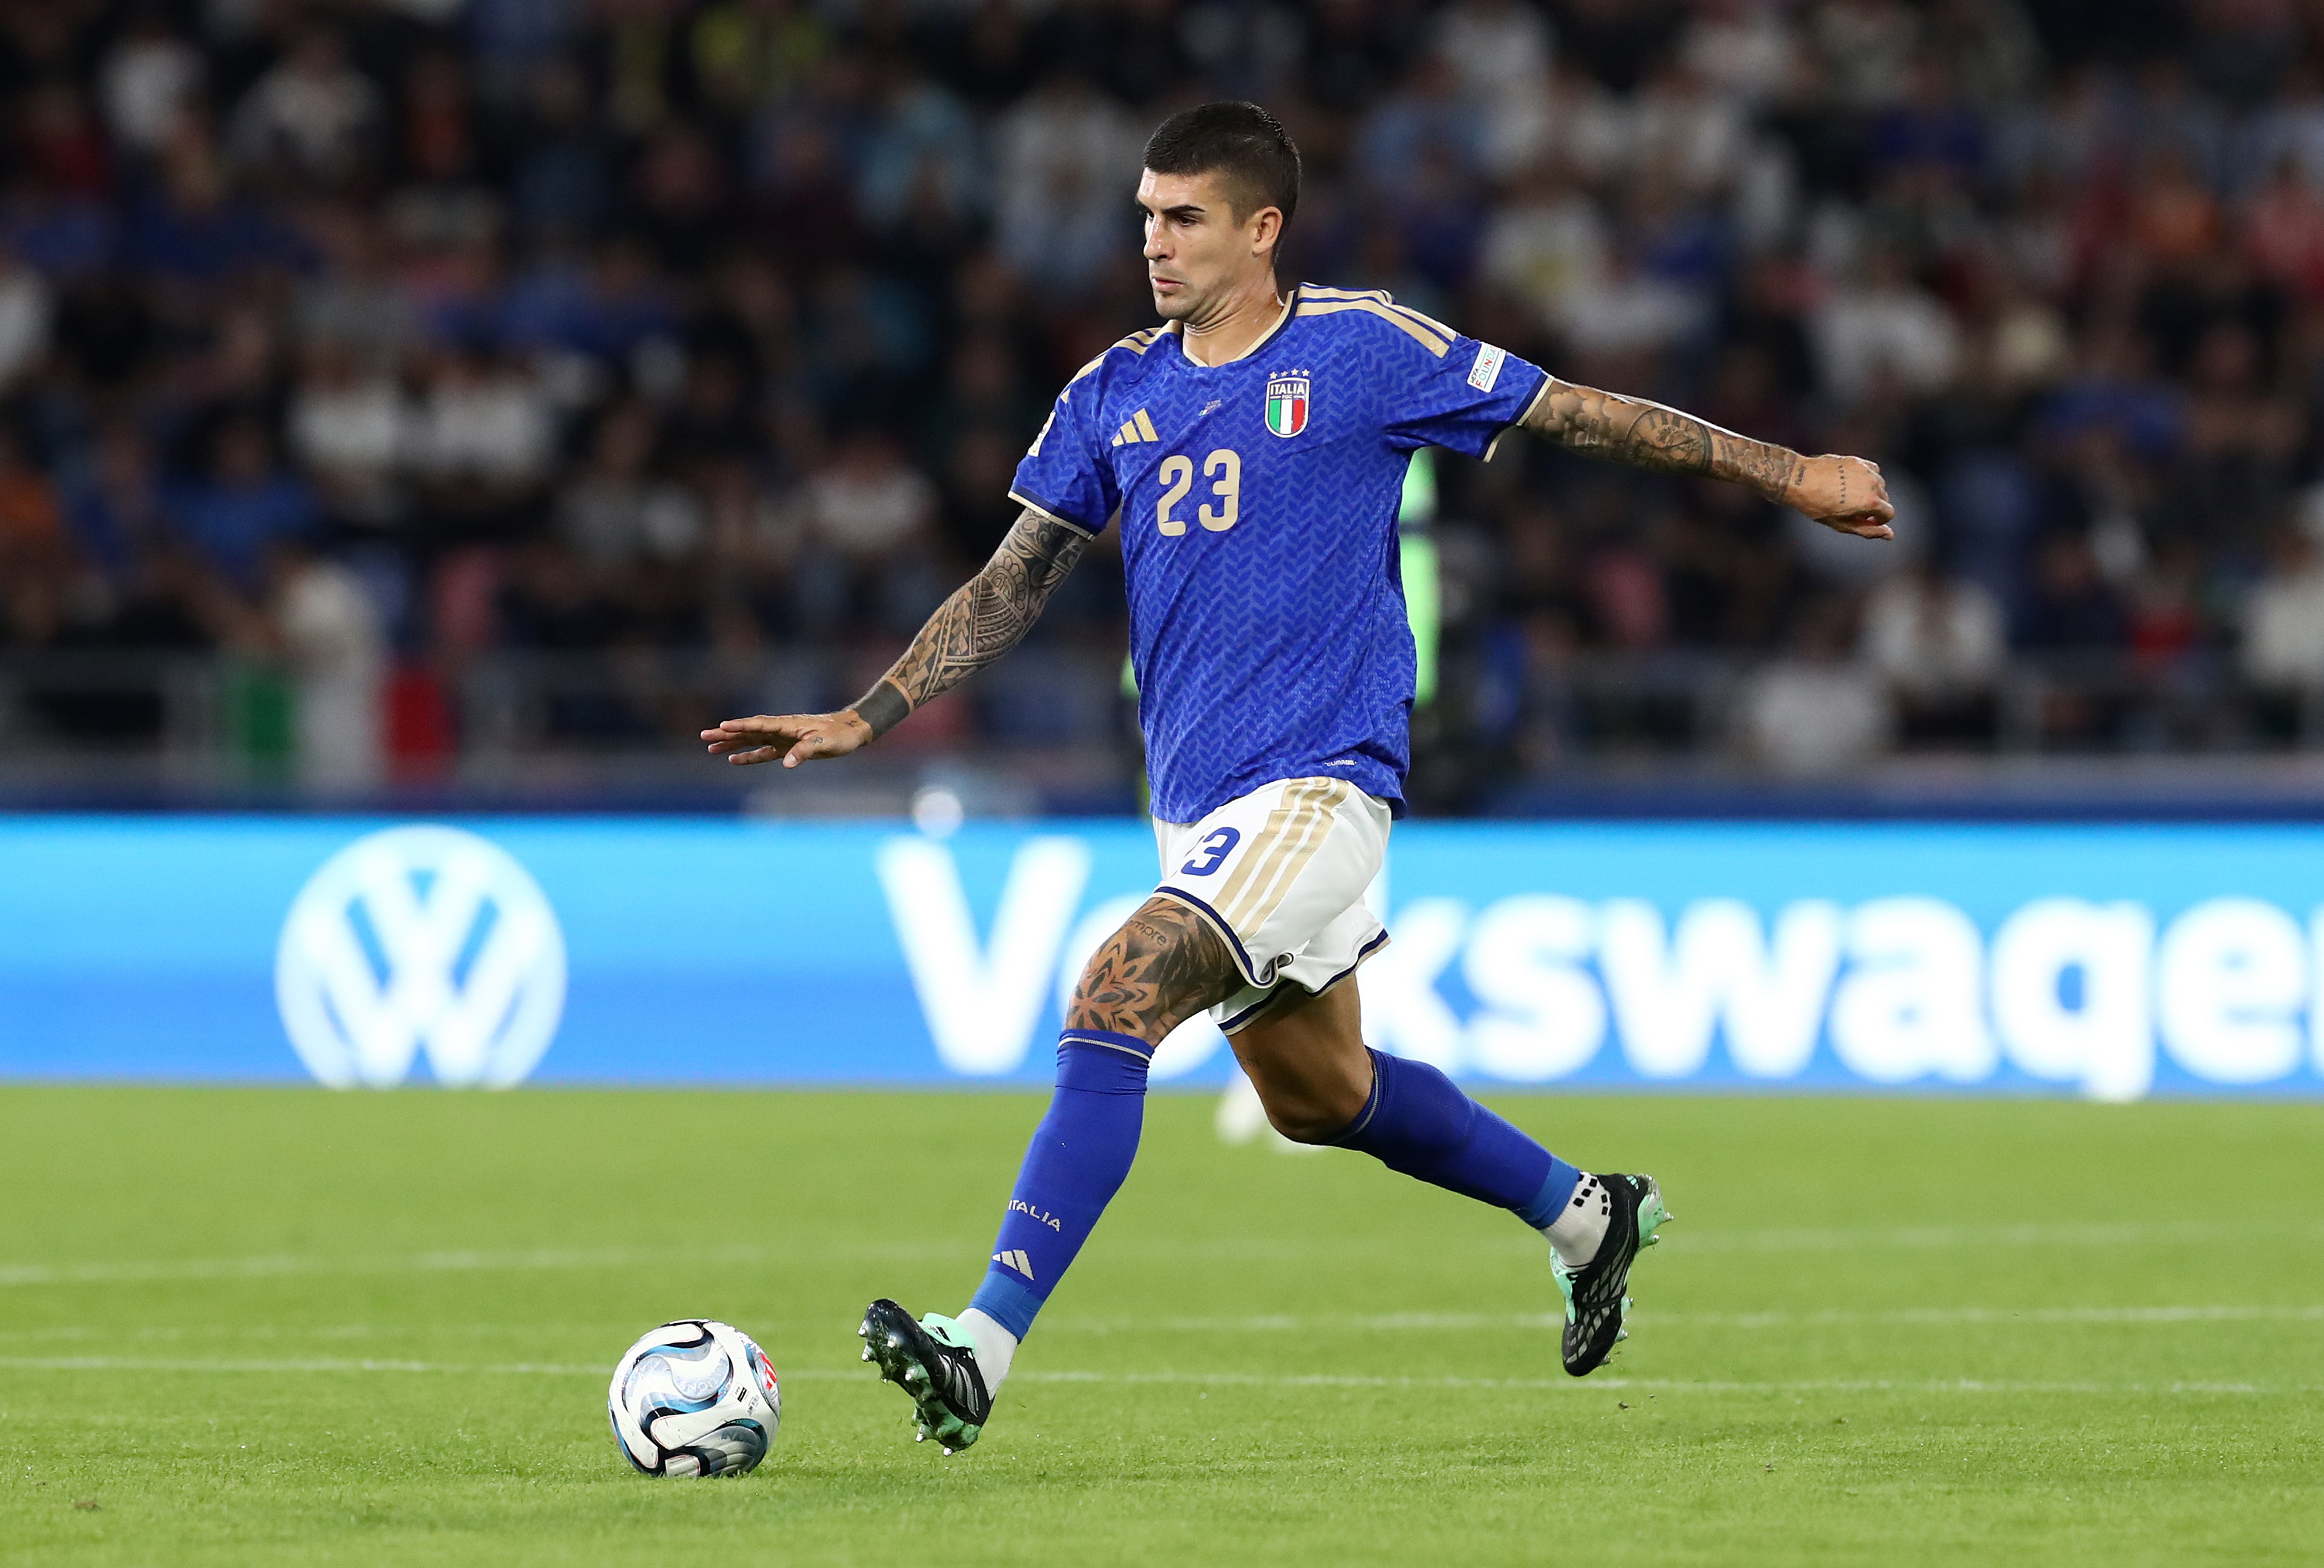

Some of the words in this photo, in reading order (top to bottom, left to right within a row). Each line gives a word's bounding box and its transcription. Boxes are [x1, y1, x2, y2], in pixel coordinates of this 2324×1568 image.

[1270, 383, 1305, 395] ITALIA
[1156, 449, 1241, 536] 23
[1181, 827, 1241, 877] 3
[875, 834, 2324, 1102] Vkswage
[1008, 1199, 1060, 1232] ITALIA
